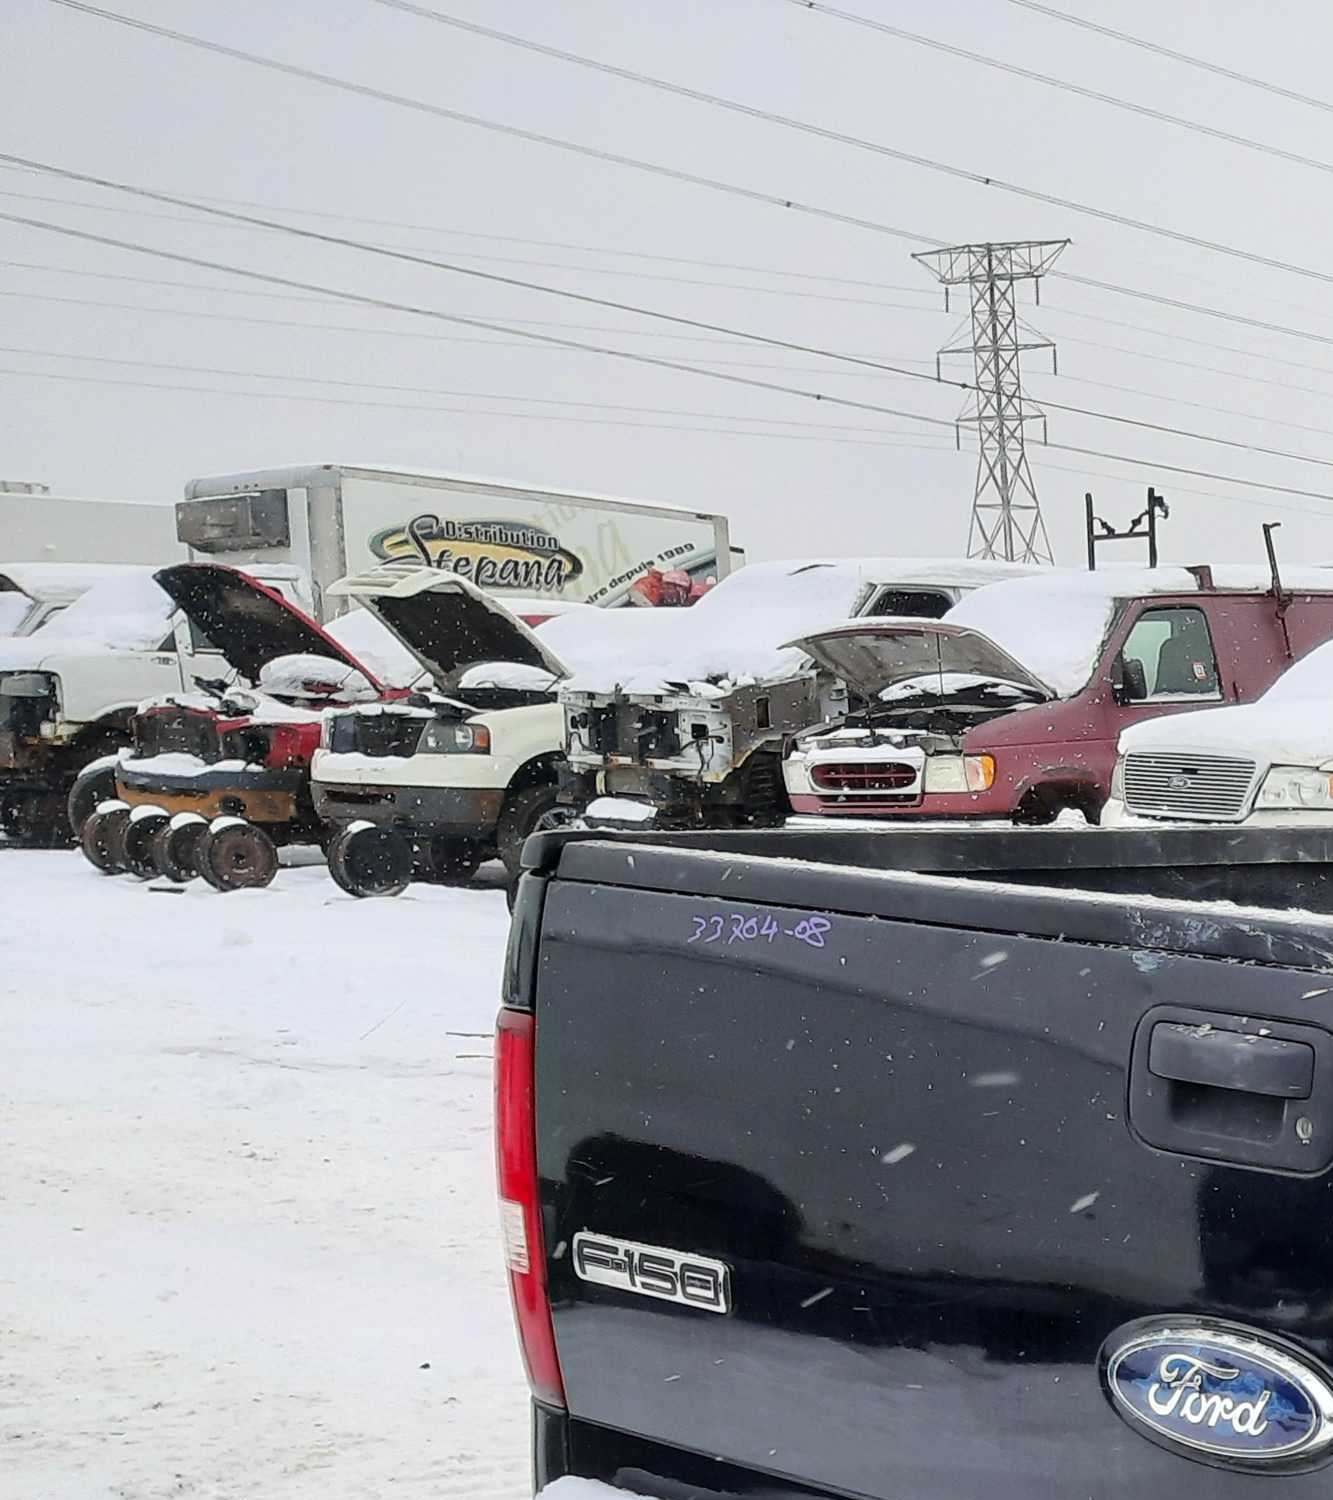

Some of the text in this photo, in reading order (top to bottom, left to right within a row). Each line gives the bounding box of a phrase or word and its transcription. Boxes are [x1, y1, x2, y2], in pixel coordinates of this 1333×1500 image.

[382, 513, 567, 591] Stepana
[444, 520, 560, 550] Distribution
[608, 559, 656, 590] depuis
[656, 542, 696, 562] 1989
[574, 1234, 730, 1312] F-150
[1148, 1353, 1272, 1437] Ford
